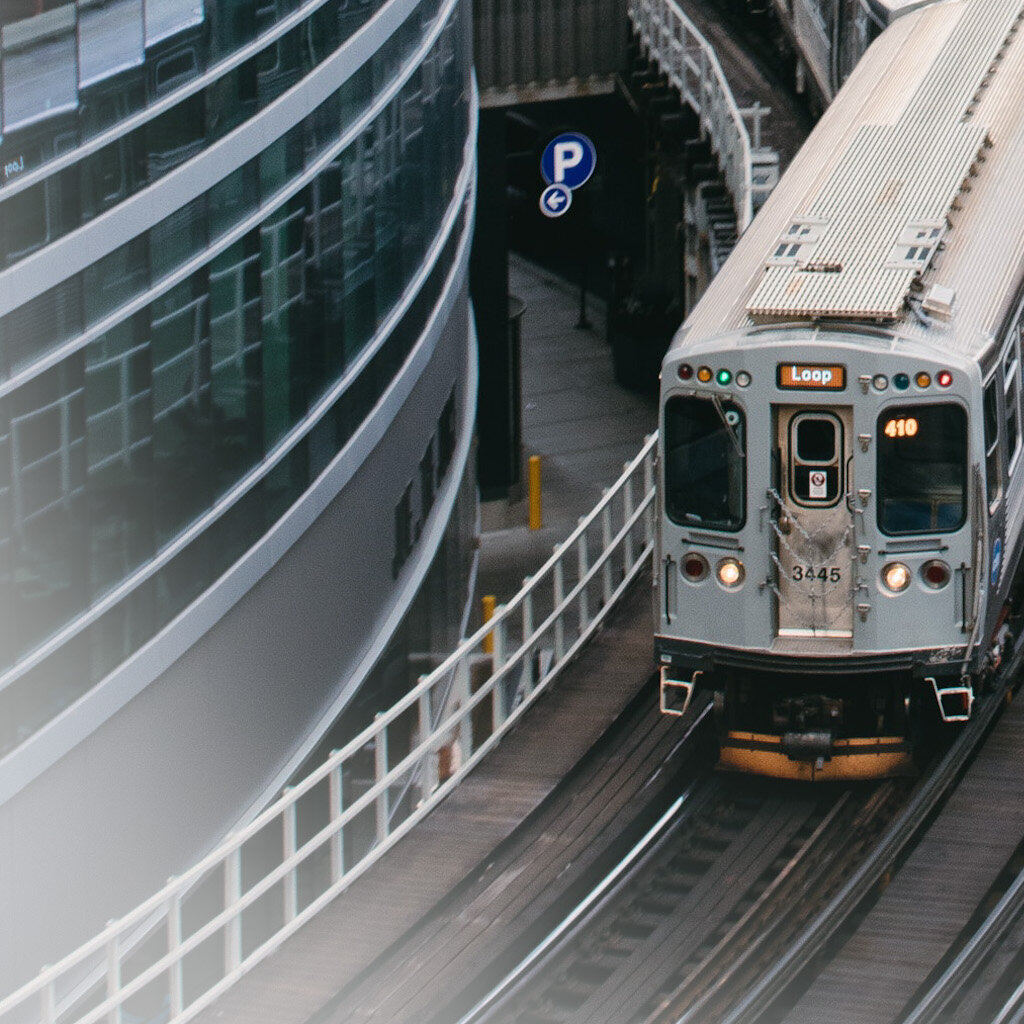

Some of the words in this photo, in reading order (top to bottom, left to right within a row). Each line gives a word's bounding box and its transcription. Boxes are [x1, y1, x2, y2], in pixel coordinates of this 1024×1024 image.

[554, 141, 584, 182] P
[792, 366, 832, 385] Loop
[884, 418, 918, 437] 410
[792, 565, 841, 583] 3445
